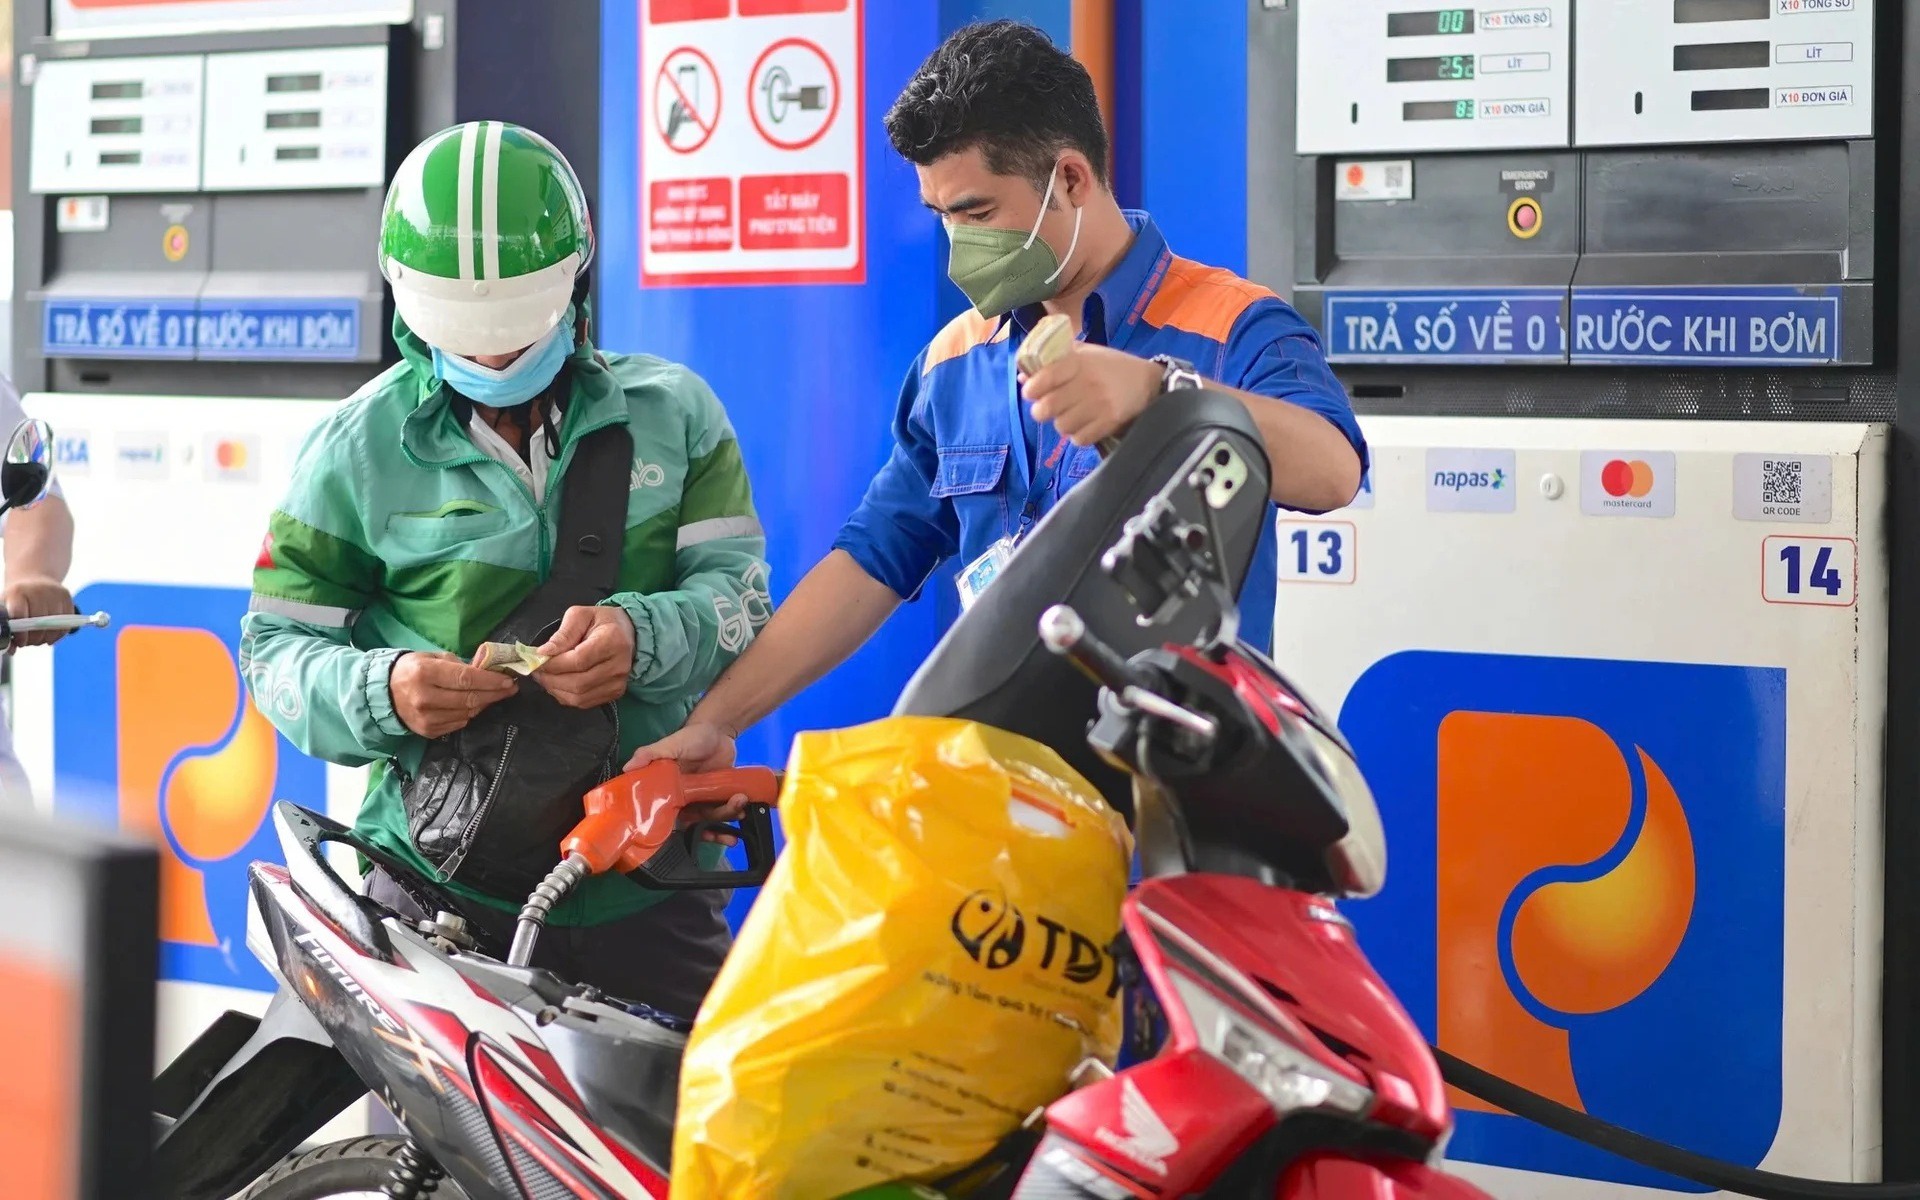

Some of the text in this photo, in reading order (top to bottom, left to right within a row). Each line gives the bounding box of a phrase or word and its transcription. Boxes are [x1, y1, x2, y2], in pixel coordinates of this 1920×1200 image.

[1437, 11, 1465, 33] 00
[1484, 16, 1501, 26] X10
[1806, 47, 1822, 58] LÍT
[1507, 58, 1522, 69] LÍT
[1780, 89, 1848, 104] X10 ĐƠN GIÁ
[1484, 105, 1501, 115] X10
[1528, 102, 1546, 113] GIÁ
[1502, 170, 1549, 181] EMERGENCY
[1515, 181, 1536, 191] STOP
[54, 303, 93, 345] TRẢ
[97, 305, 127, 347] SỐ
[130, 304, 161, 347] VỀ
[263, 315, 298, 347] KHI
[302, 312, 350, 348] BƠM
[1344, 302, 1403, 351] TRẢ
[1413, 301, 1459, 351] SỐ
[1468, 300, 1514, 351] VỀ
[1684, 317, 1736, 352] KHI
[1749, 311, 1827, 354] BƠM
[56, 438, 89, 462] ISA
[1434, 471, 1489, 491] napas
[1603, 499, 1652, 509] mastercard
[1762, 507, 1801, 516] QR CODE
[1291, 530, 1342, 575] 13
[1780, 545, 1842, 596] 14
